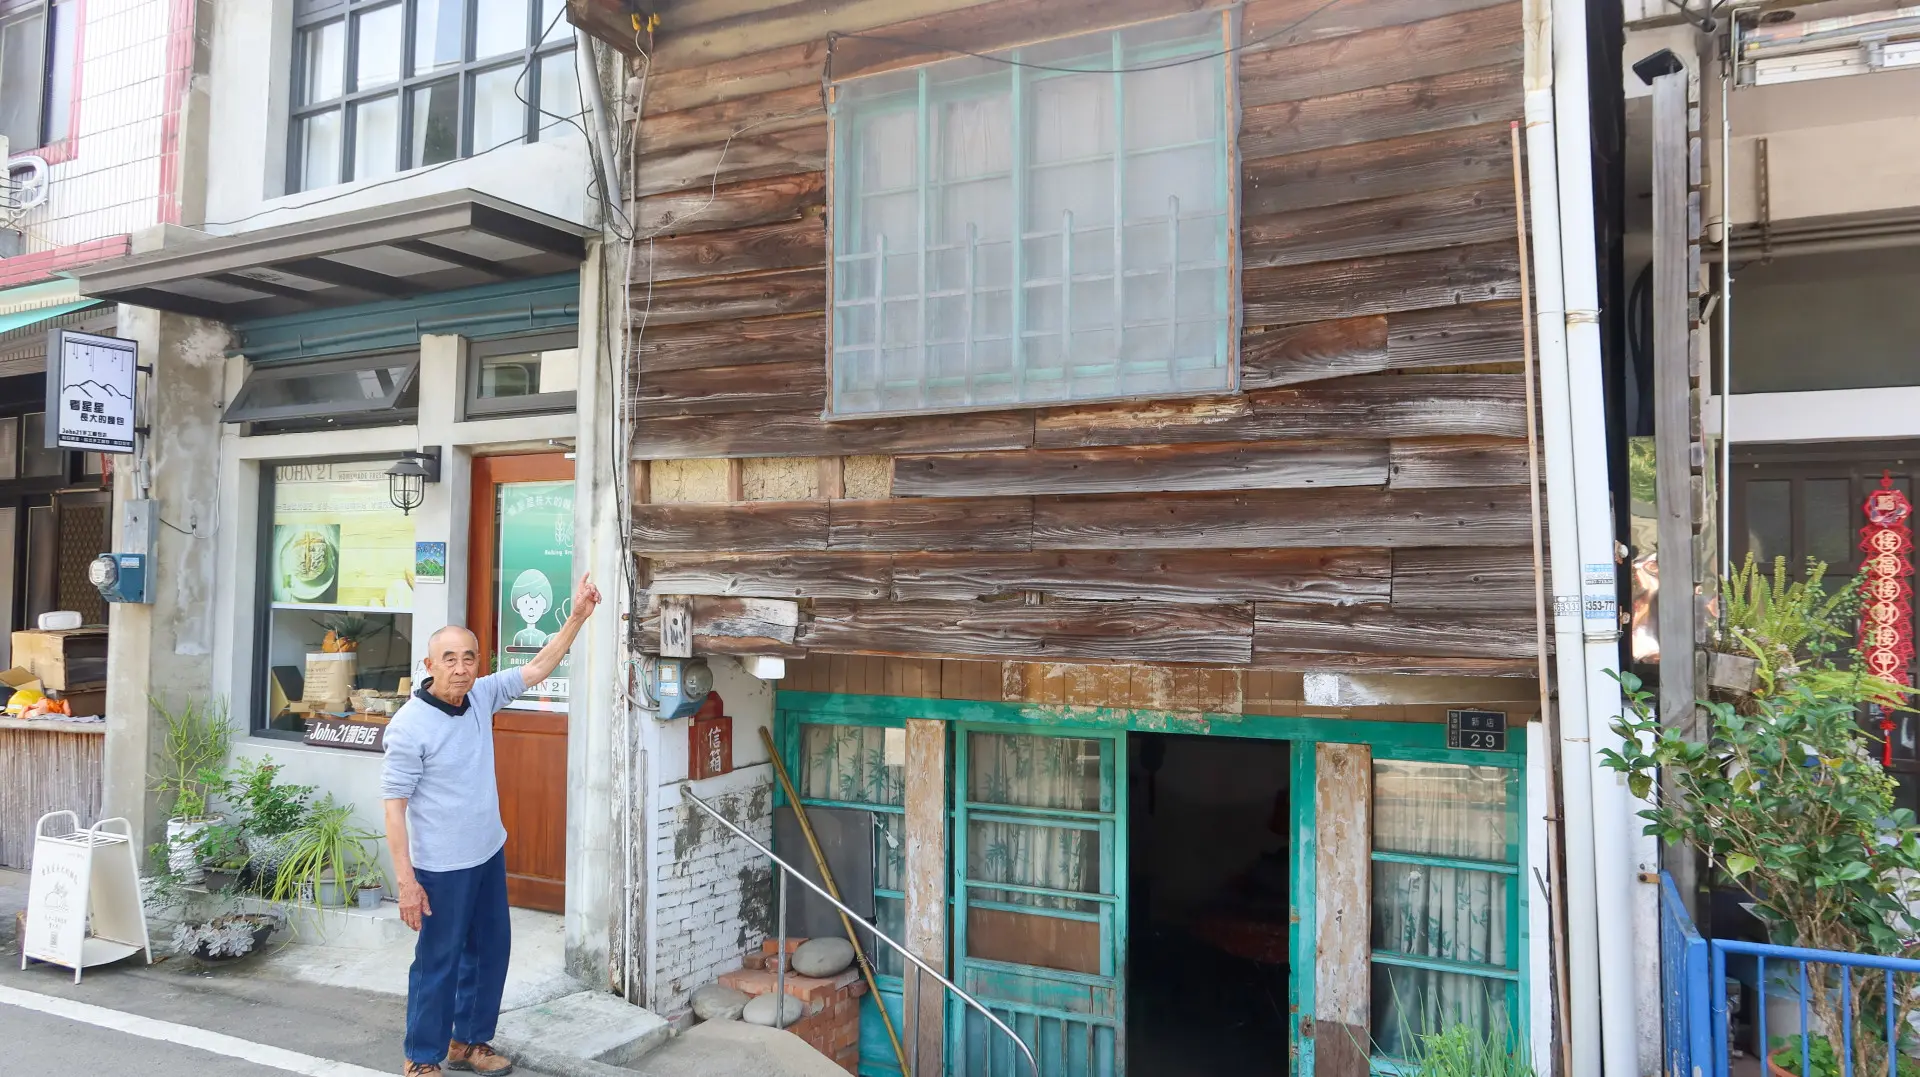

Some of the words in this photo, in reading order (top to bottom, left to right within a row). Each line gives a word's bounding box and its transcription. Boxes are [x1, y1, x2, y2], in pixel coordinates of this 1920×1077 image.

[309, 721, 380, 746] John21麵包店
[1470, 733, 1495, 748] 29
[707, 725, 722, 773] 信箱
